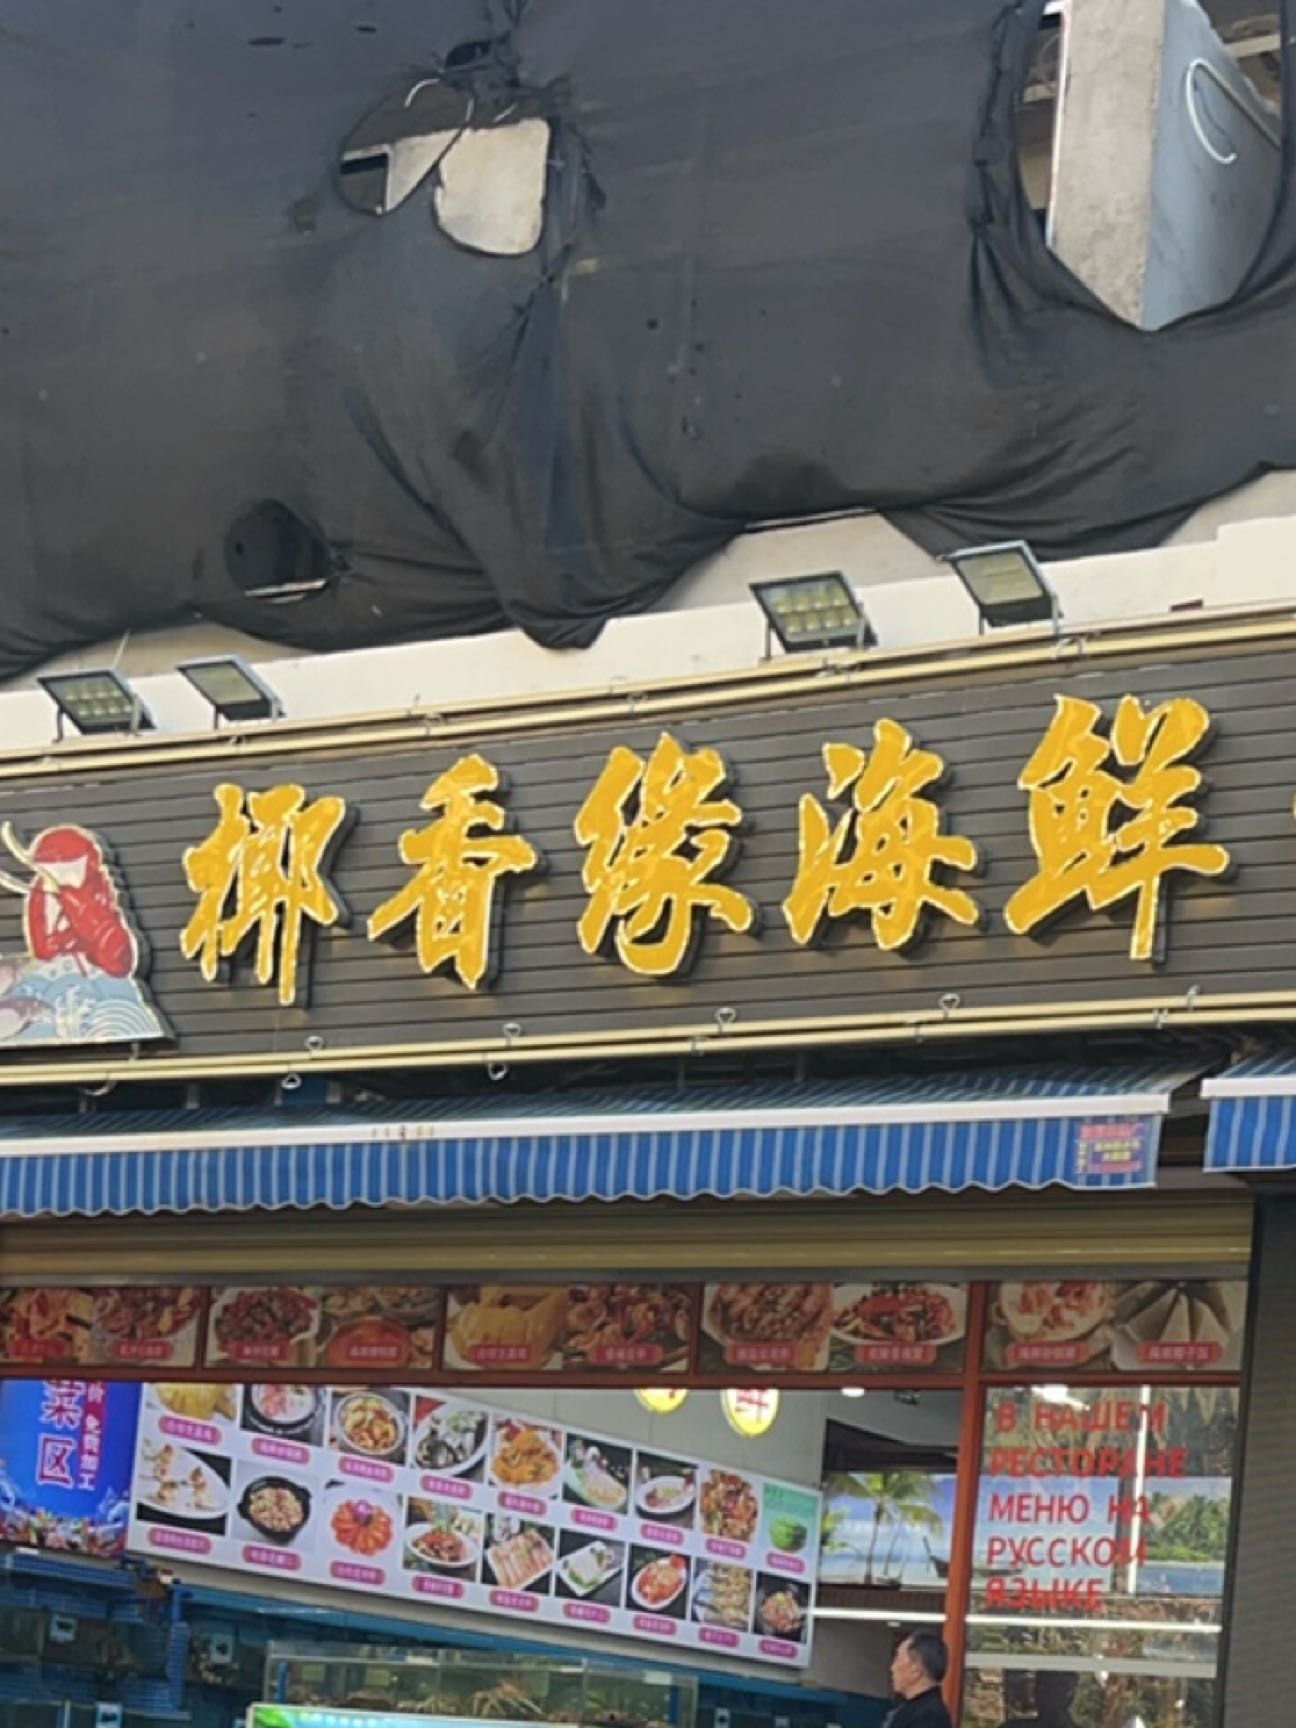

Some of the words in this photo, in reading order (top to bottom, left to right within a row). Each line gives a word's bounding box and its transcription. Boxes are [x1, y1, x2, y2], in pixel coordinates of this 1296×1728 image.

[988, 1492, 1090, 1524] МЕНЮ
[1108, 1493, 1151, 1525] НА
[986, 1534, 1147, 1568] РУССКОМ
[985, 1576, 1105, 1613] ЯЗЫКЕ
